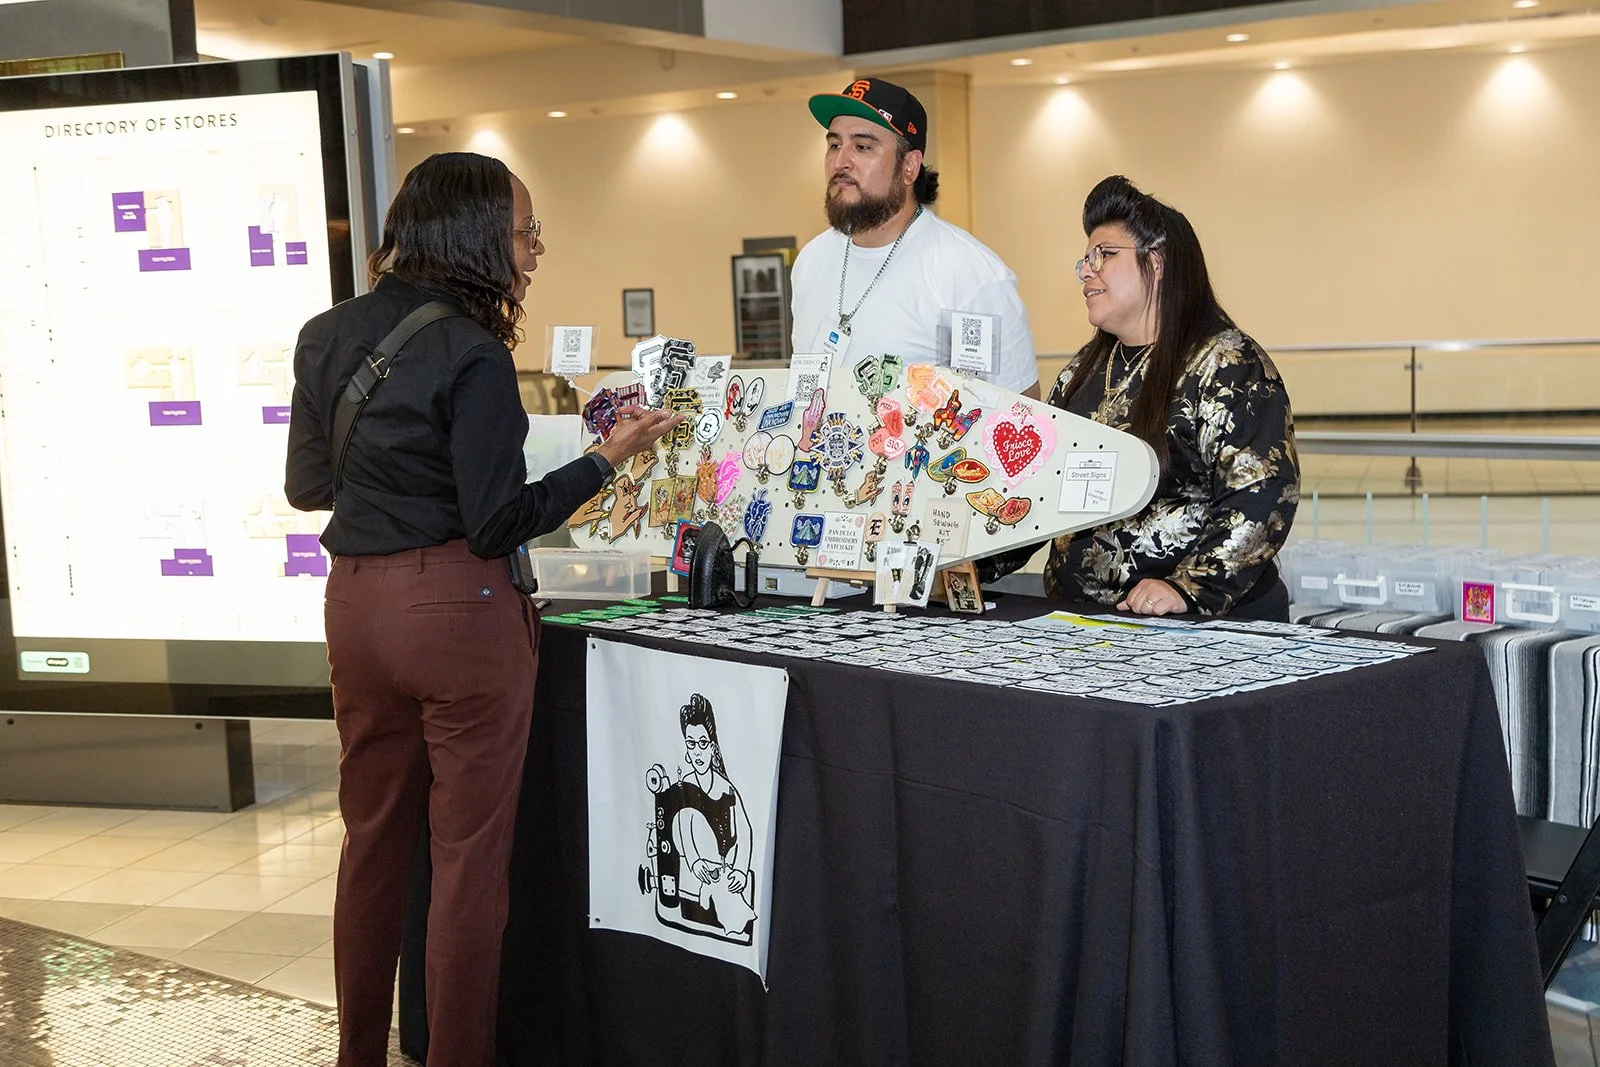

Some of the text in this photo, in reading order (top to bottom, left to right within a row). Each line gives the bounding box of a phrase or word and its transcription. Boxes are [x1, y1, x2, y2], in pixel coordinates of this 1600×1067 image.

[45, 113, 238, 138] DIRECTORY OF STORES
[702, 422, 713, 433] E
[871, 435, 882, 447] 707
[887, 439, 900, 450] 510
[1002, 438, 1033, 453] Frisco
[1007, 448, 1032, 463] Love
[1071, 471, 1107, 480] Street Signs
[932, 508, 951, 519] HAND
[869, 518, 883, 536] E
[933, 519, 959, 529] SEWING
[938, 529, 951, 537] KIT
[824, 536, 858, 544] EMBROIDERY
